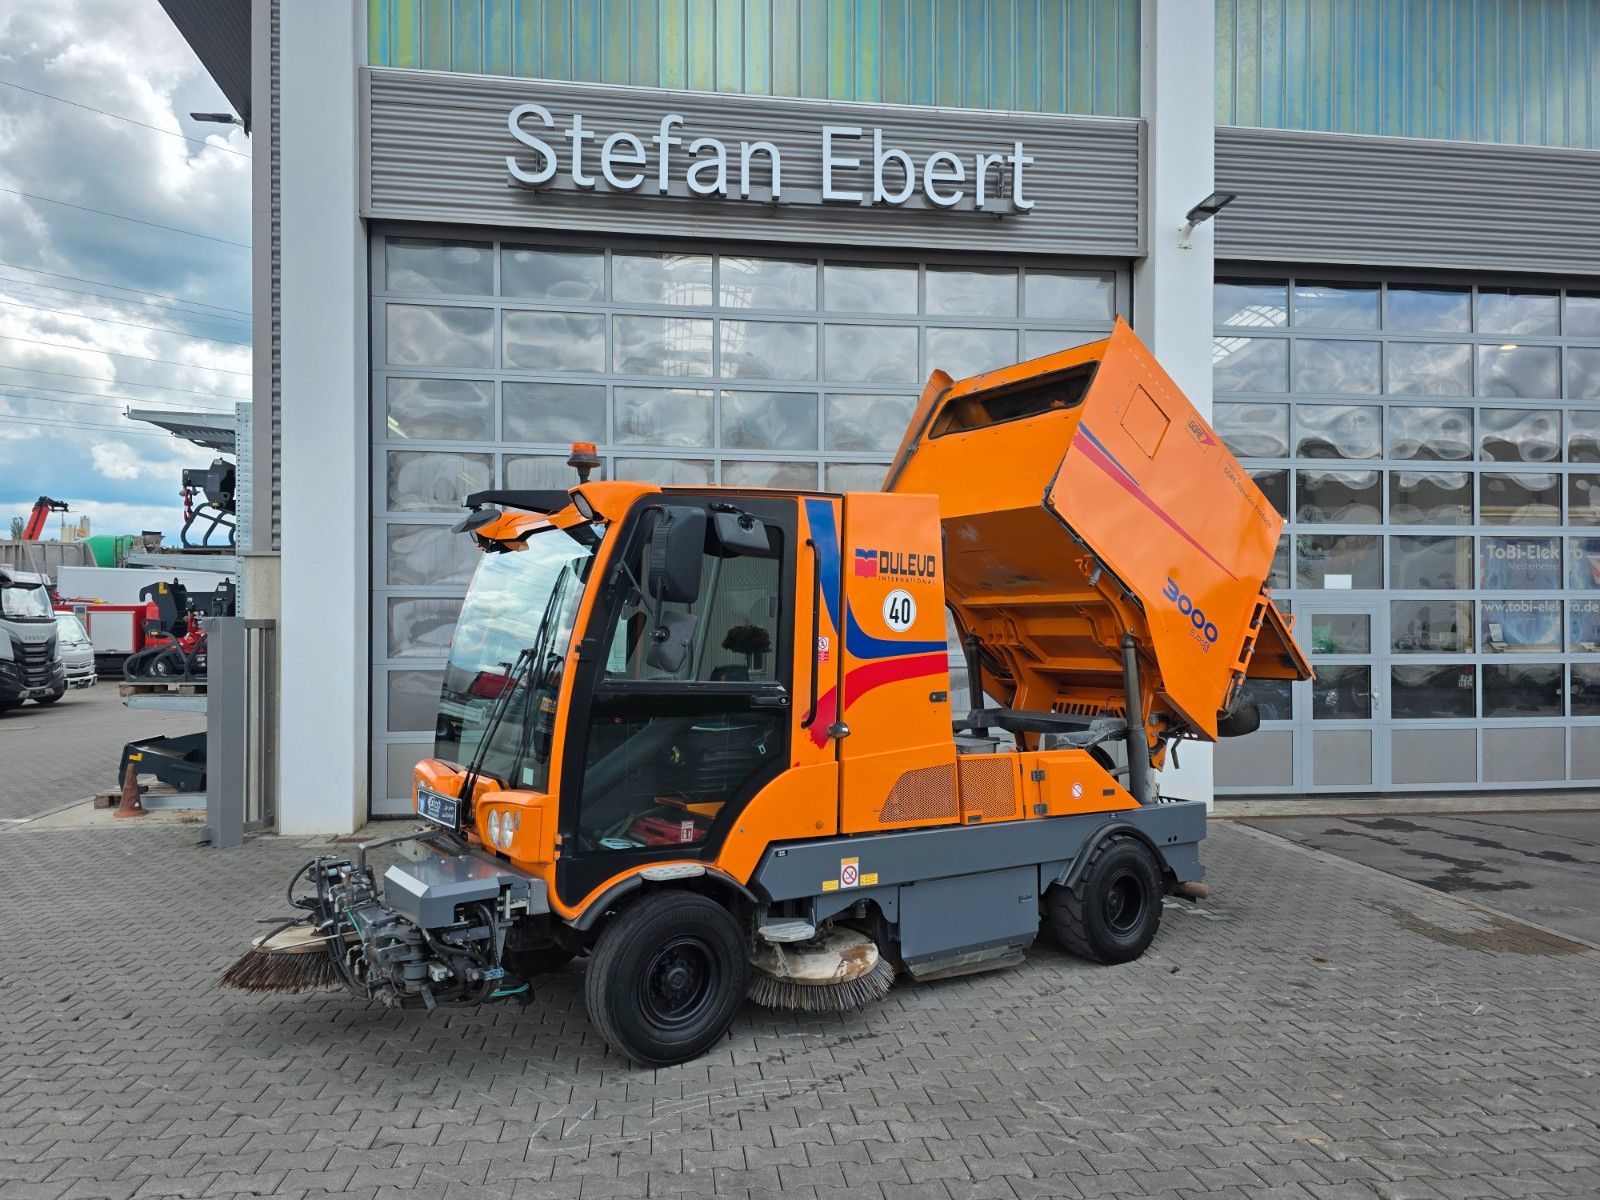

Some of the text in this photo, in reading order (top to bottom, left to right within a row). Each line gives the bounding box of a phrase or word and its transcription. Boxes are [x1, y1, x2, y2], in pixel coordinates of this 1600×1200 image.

[506, 103, 1034, 210] Stefan Ebert
[1187, 420, 1205, 440] GORE
[879, 551, 936, 577] DULEVO
[878, 576, 936, 585] INTERNATIONAL
[889, 597, 911, 624] 40
[1162, 576, 1218, 643] 3000
